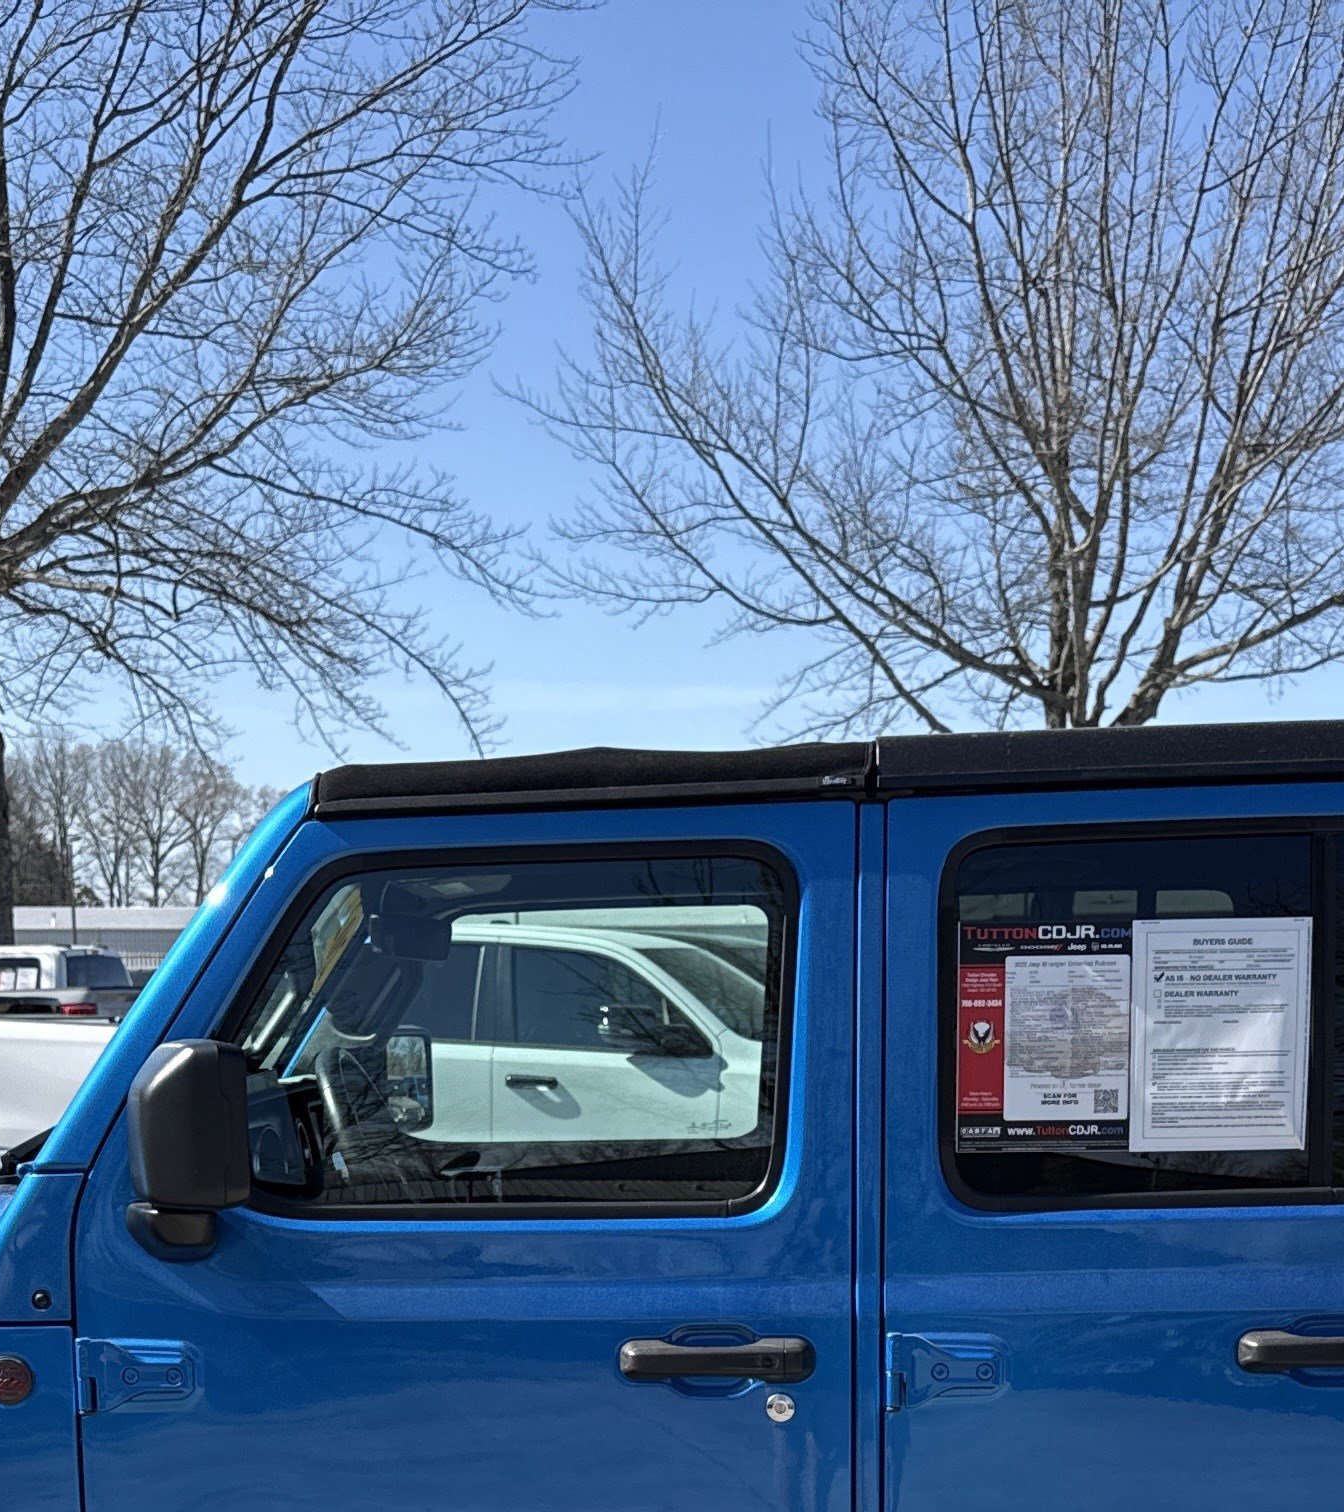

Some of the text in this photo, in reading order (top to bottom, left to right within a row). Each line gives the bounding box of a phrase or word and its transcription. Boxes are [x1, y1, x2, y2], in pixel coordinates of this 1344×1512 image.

[963, 925, 1133, 940] TUTTONCDJR.COM
[1192, 937, 1253, 946] BUYERS GUIDE
[1067, 943, 1087, 951] Jeep
[1234, 973, 1277, 981] WARRANTY
[1164, 990, 1195, 998] DEALER
[1007, 1125, 1124, 1136] www.TuttonCDJR.com
